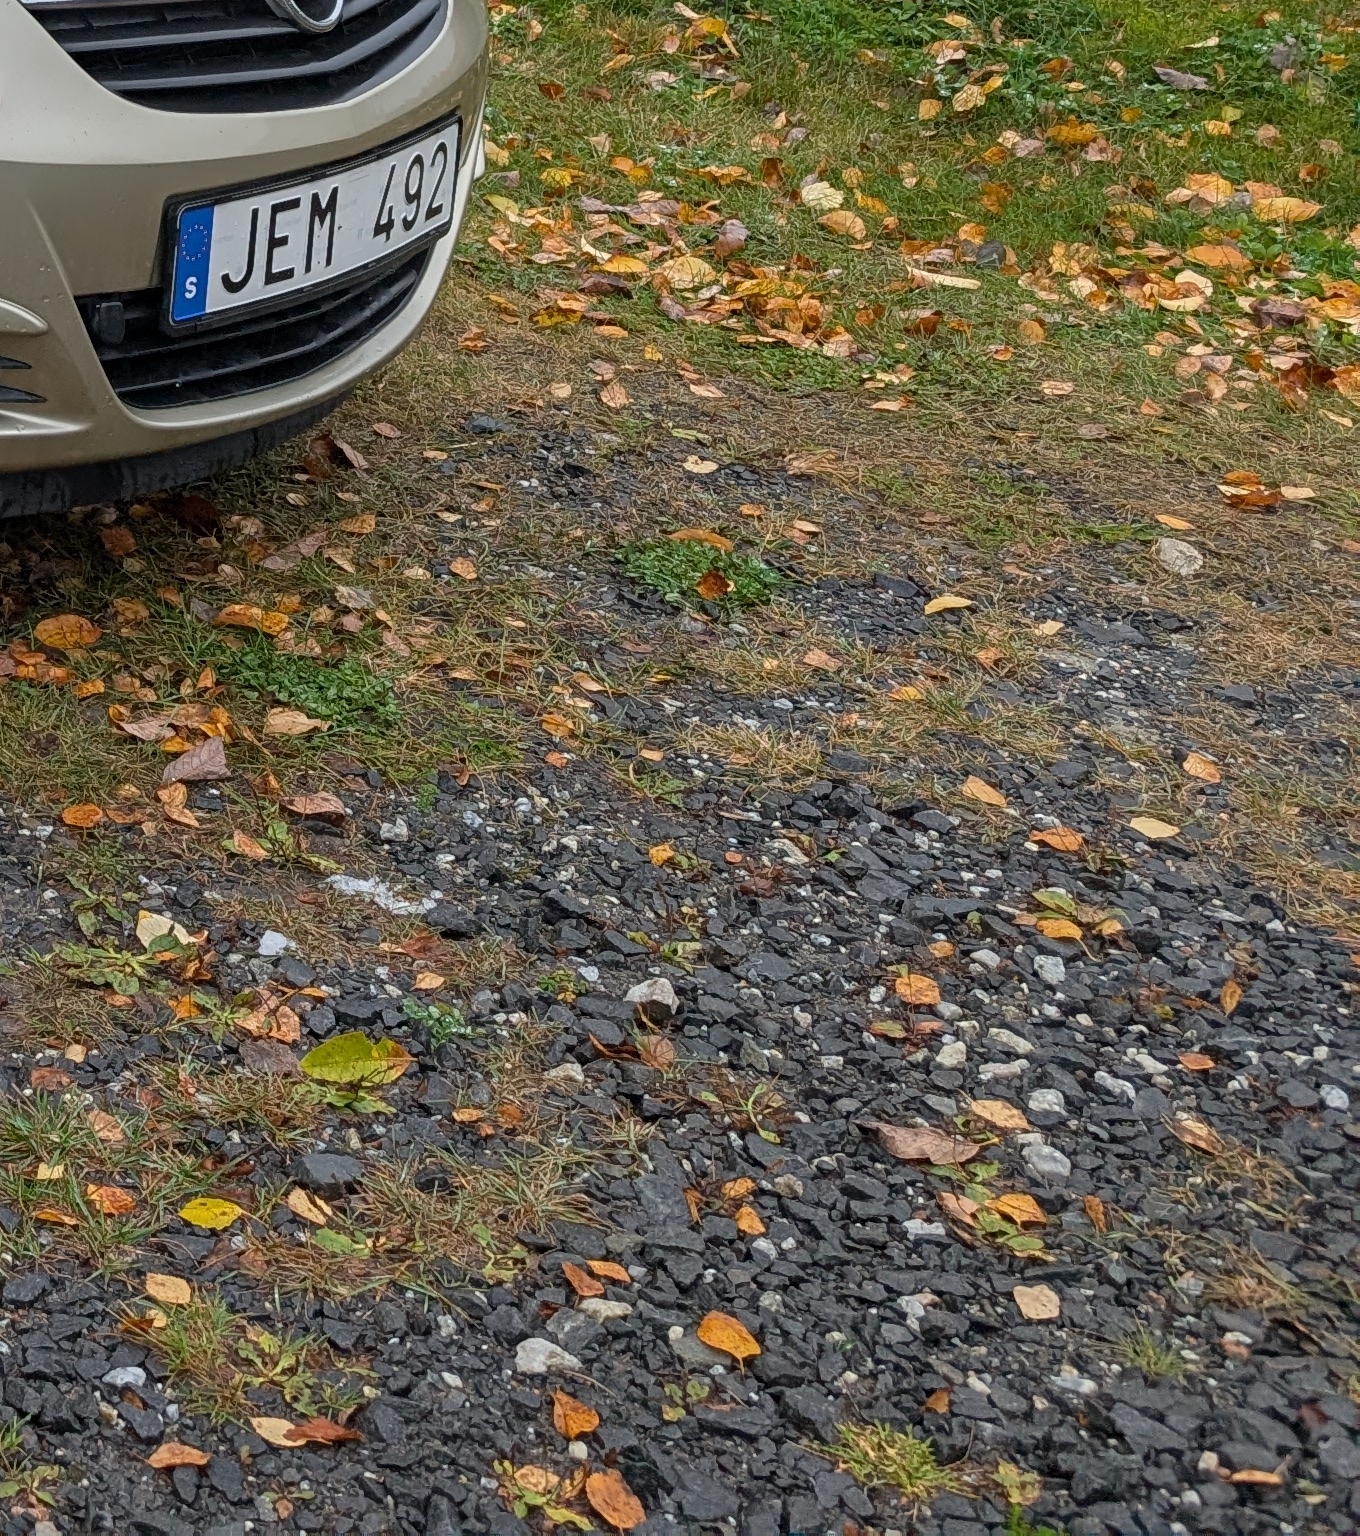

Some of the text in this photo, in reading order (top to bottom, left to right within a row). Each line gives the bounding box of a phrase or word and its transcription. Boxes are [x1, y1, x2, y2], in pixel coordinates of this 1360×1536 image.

[220, 141, 448, 294] JEM 492
[184, 276, 198, 299] S
